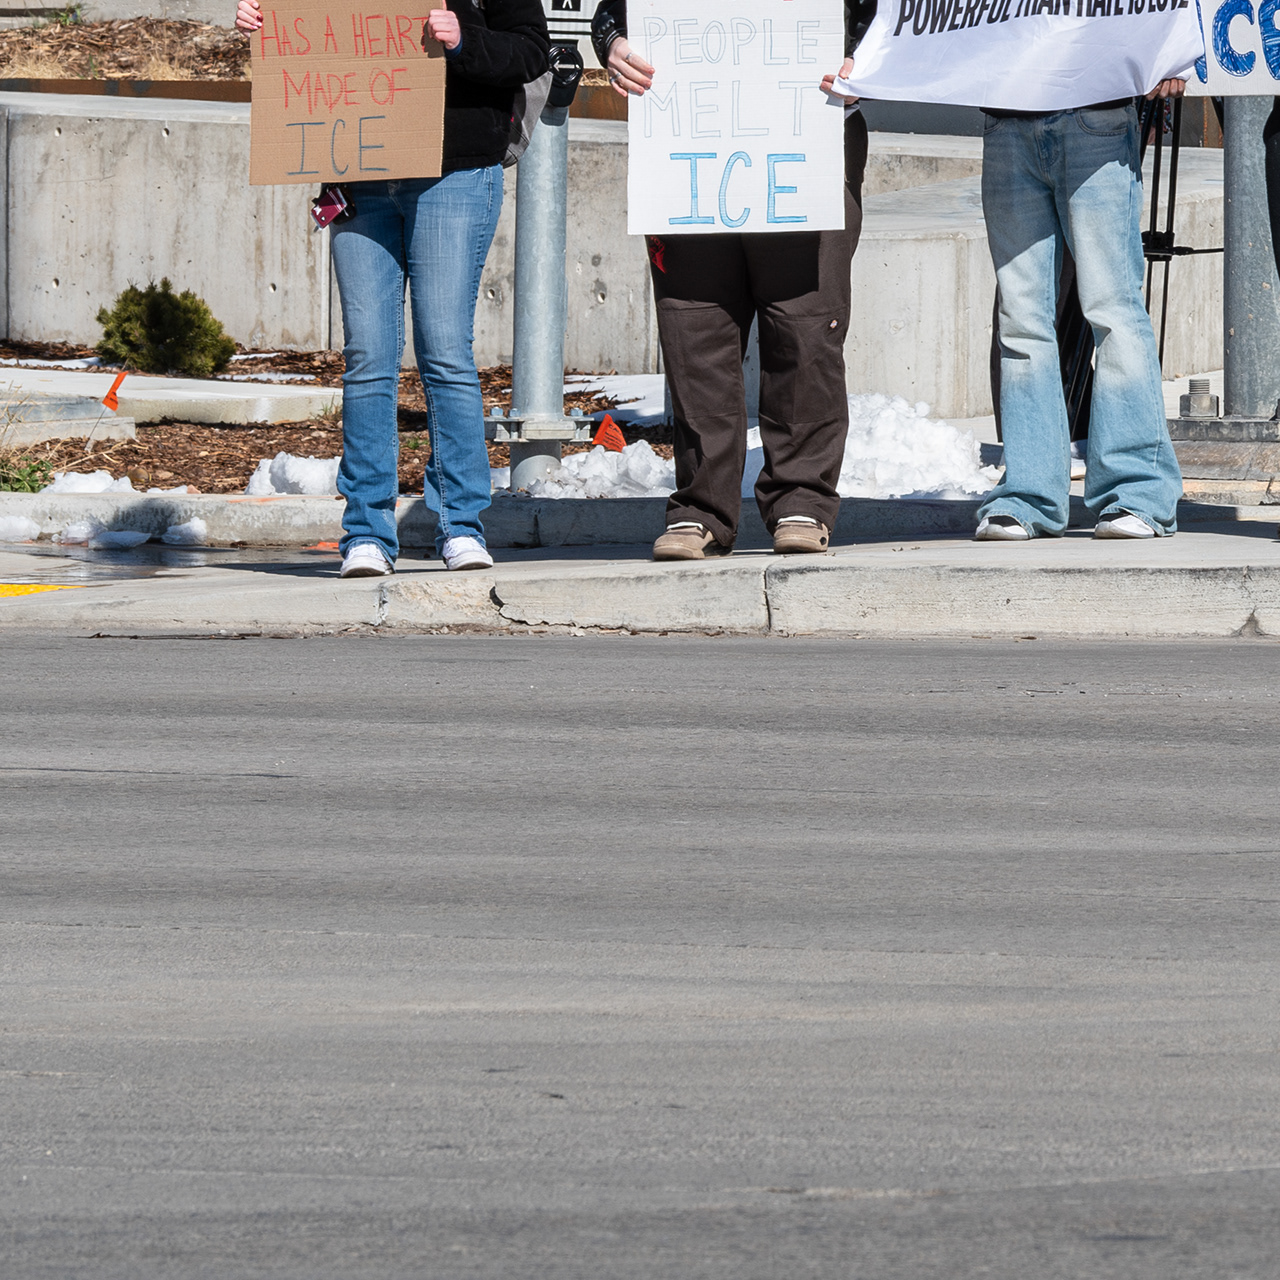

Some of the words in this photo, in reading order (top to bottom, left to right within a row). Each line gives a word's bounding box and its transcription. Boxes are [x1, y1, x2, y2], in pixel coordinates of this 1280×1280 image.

[324, 13, 338, 53] A
[352, 12, 429, 58] HEART
[643, 17, 821, 66] PEOPLE
[282, 68, 360, 114] MADE
[369, 67, 411, 105] OF
[644, 80, 820, 138] MELT
[286, 115, 390, 176] ICE
[669, 151, 808, 228] ICE
